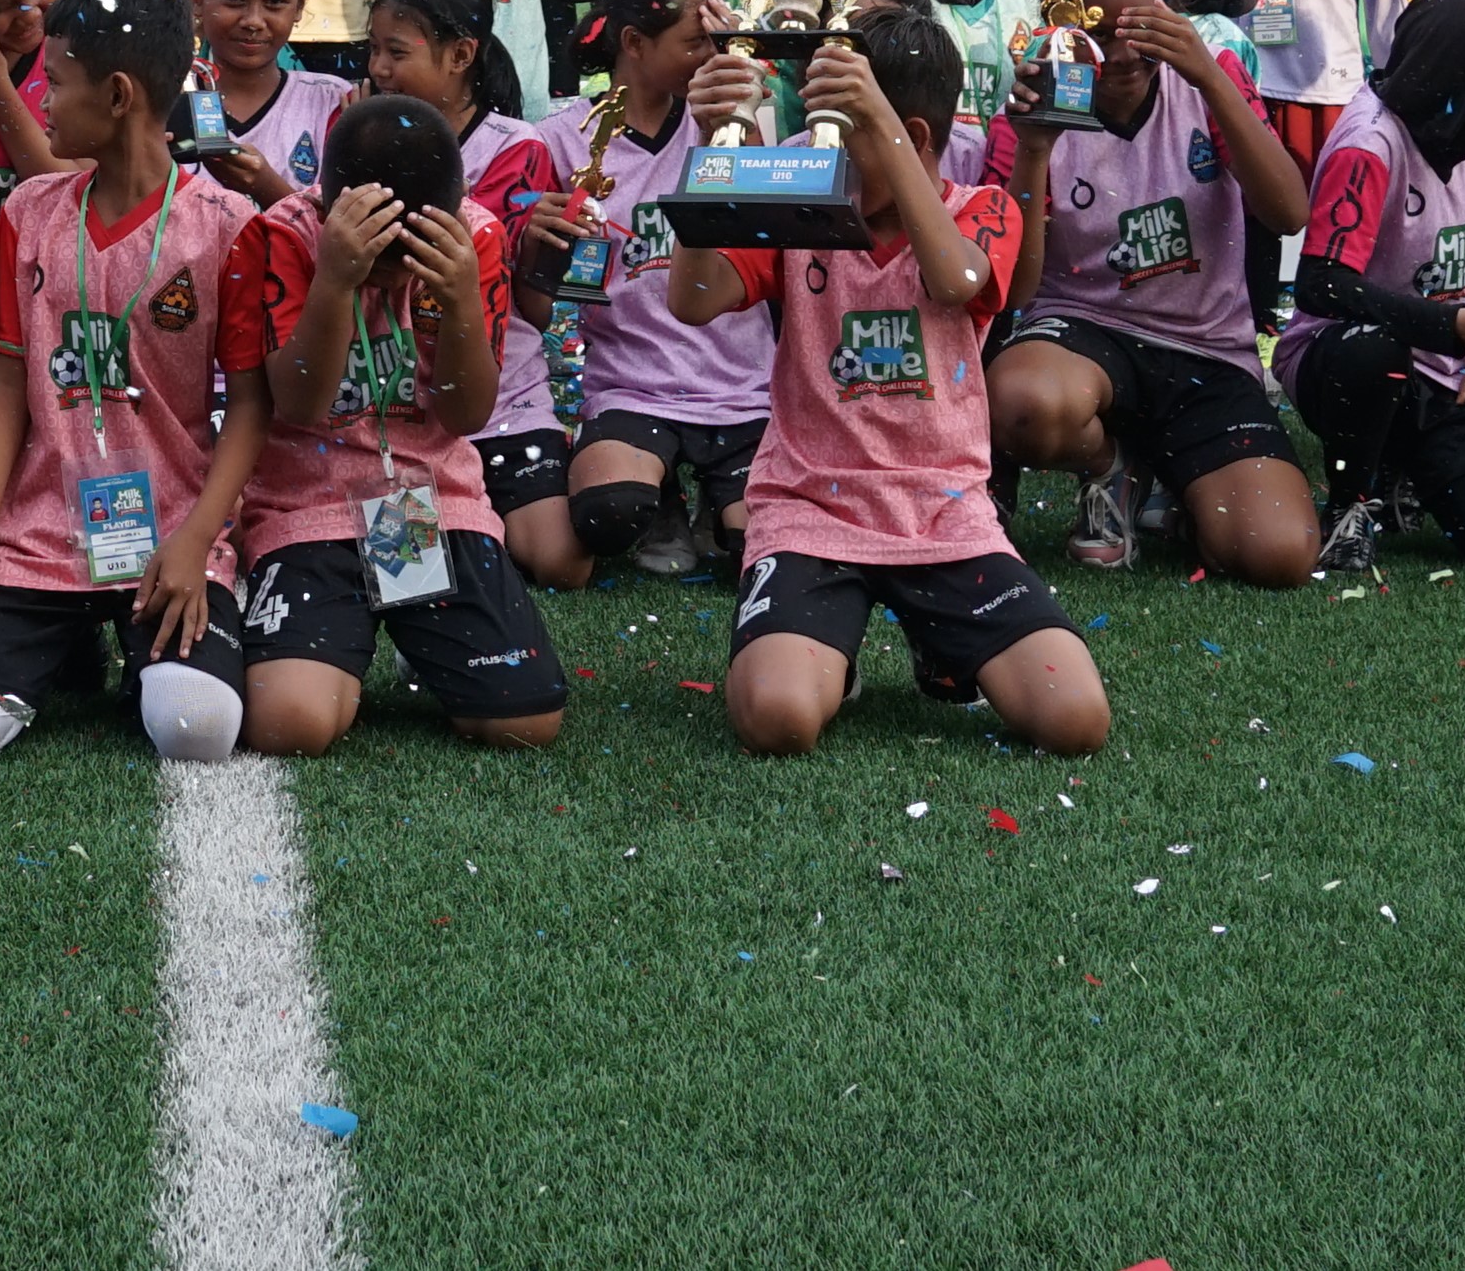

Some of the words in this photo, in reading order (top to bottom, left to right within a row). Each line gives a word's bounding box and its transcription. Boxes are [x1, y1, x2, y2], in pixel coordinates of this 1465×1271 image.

[705, 157, 732, 168] Milk
[740, 159, 770, 168] TEAM
[773, 159, 799, 168] FAIR
[801, 159, 831, 169] PLAY
[708, 166, 731, 178] Life
[772, 171, 793, 180] U10
[1127, 205, 1182, 242] Milk
[1137, 234, 1188, 267] Life
[852, 315, 915, 348] Milk
[881, 381, 922, 391] CHALLENGE
[118, 488, 141, 501] Milk
[122, 498, 144, 511] Life
[102, 519, 137, 530] PLAYER
[108, 561, 127, 572] U10
[245, 562, 289, 635] 4
[736, 557, 777, 630] 2
[972, 583, 1029, 616] ortuseight
[468, 649, 530, 668] ortuseight
